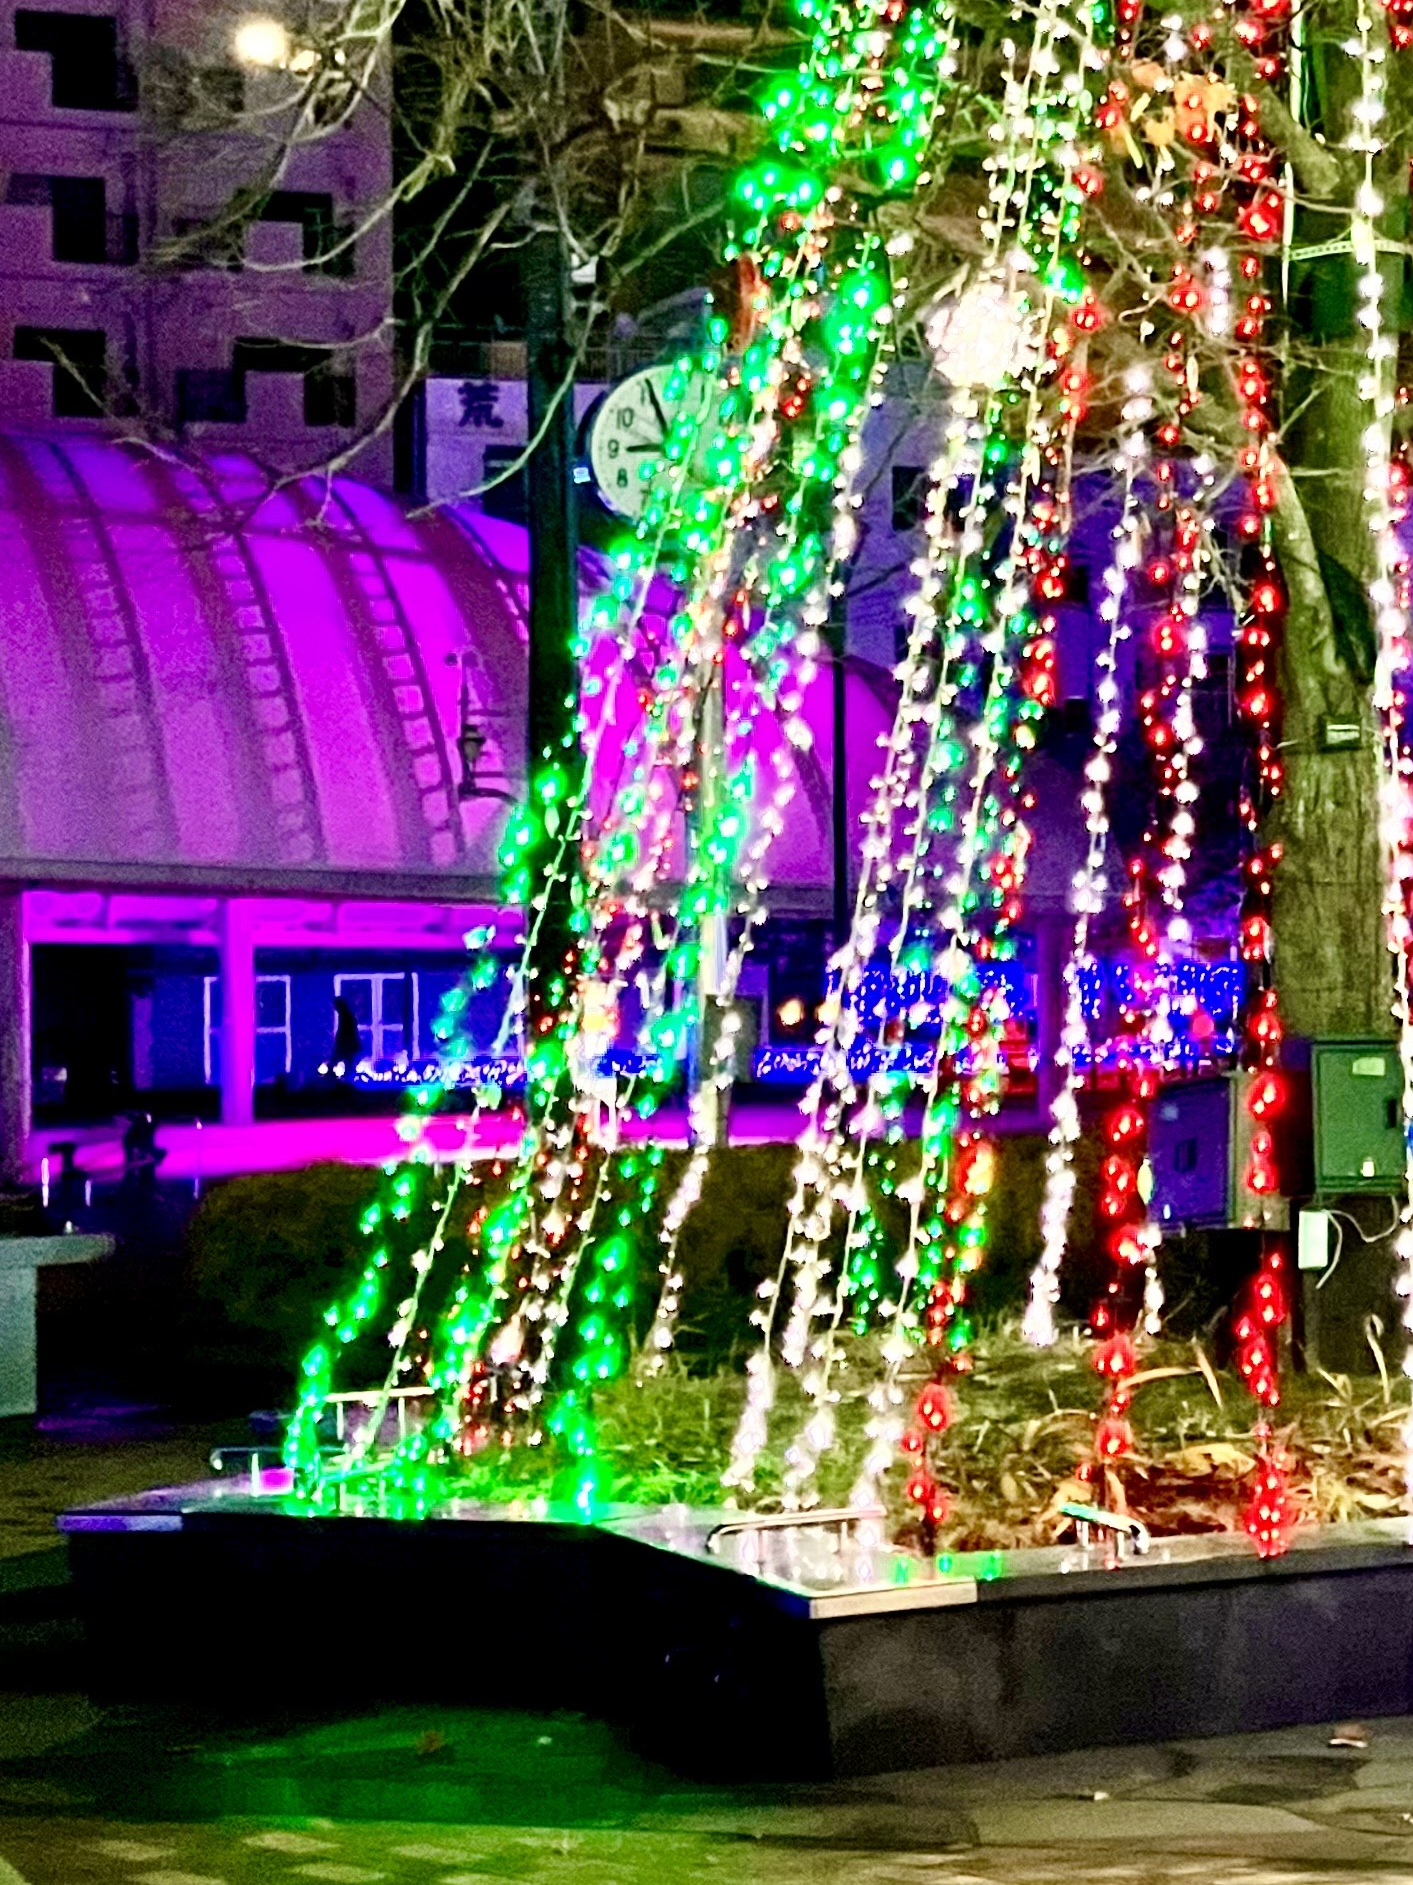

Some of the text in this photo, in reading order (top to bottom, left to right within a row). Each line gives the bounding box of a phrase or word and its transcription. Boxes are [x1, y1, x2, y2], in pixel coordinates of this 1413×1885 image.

[458, 382, 504, 427] 荒
[616, 407, 634, 430] 10
[608, 439, 619, 459] 9
[616, 468, 628, 488] 8
